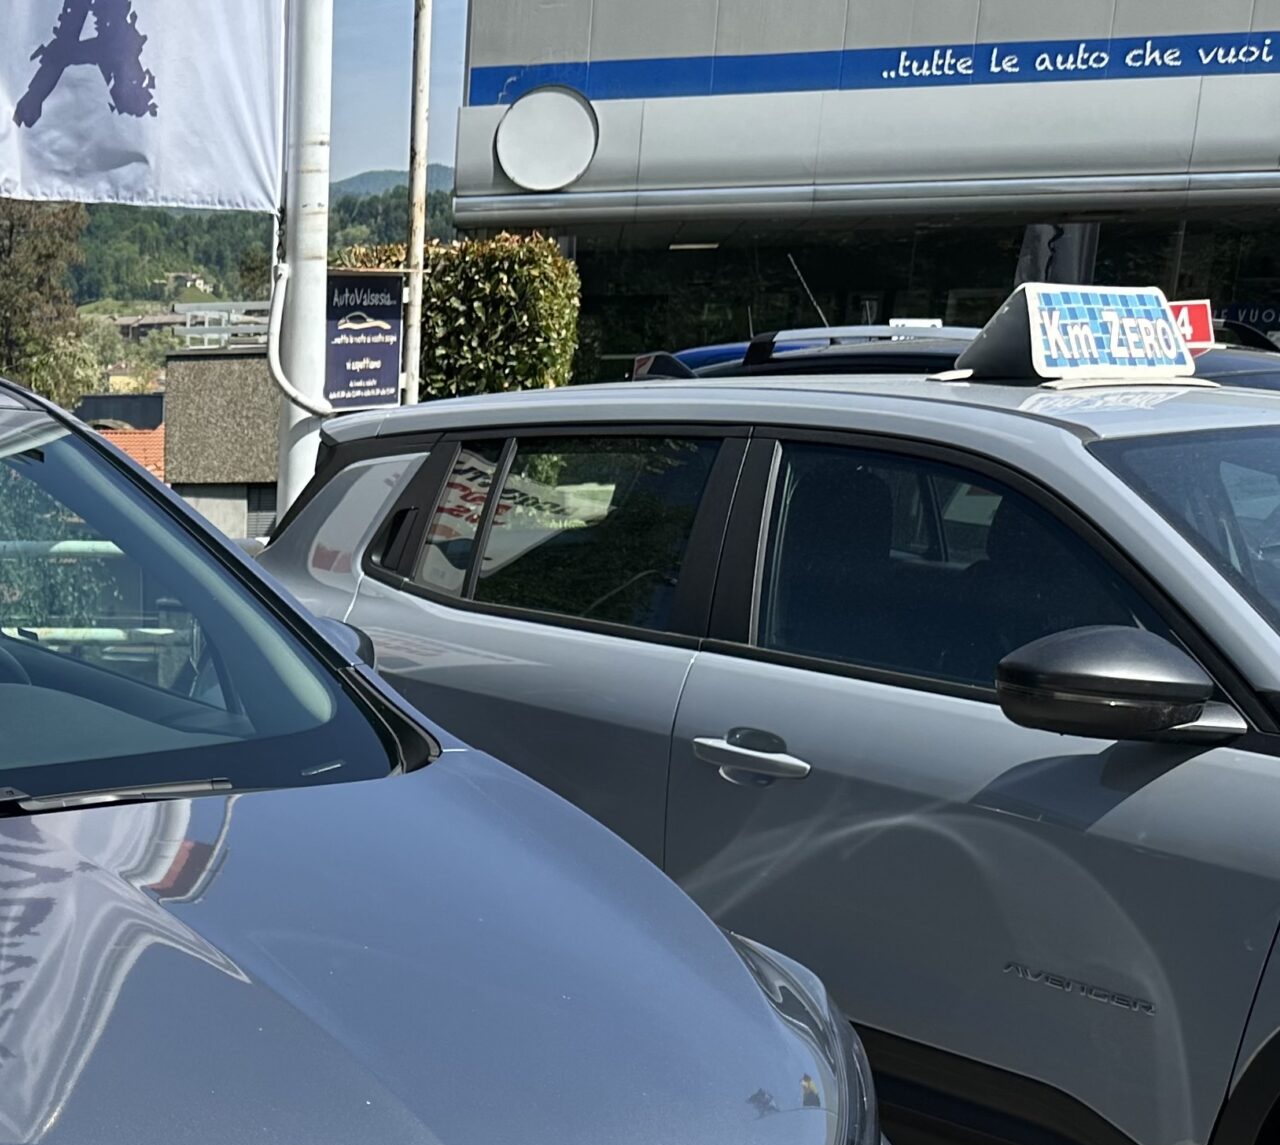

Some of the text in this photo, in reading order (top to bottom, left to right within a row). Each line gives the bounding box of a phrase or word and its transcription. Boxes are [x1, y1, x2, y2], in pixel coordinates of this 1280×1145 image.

[989, 47, 1020, 73] le
[1035, 43, 1109, 70] auto
[1125, 40, 1182, 67] che
[1198, 38, 1274, 65] vuoi
[1041, 310, 1179, 360] Km ZERO
[1238, 308, 1280, 323] VUO
[1003, 962, 1155, 1016] AVENGER
